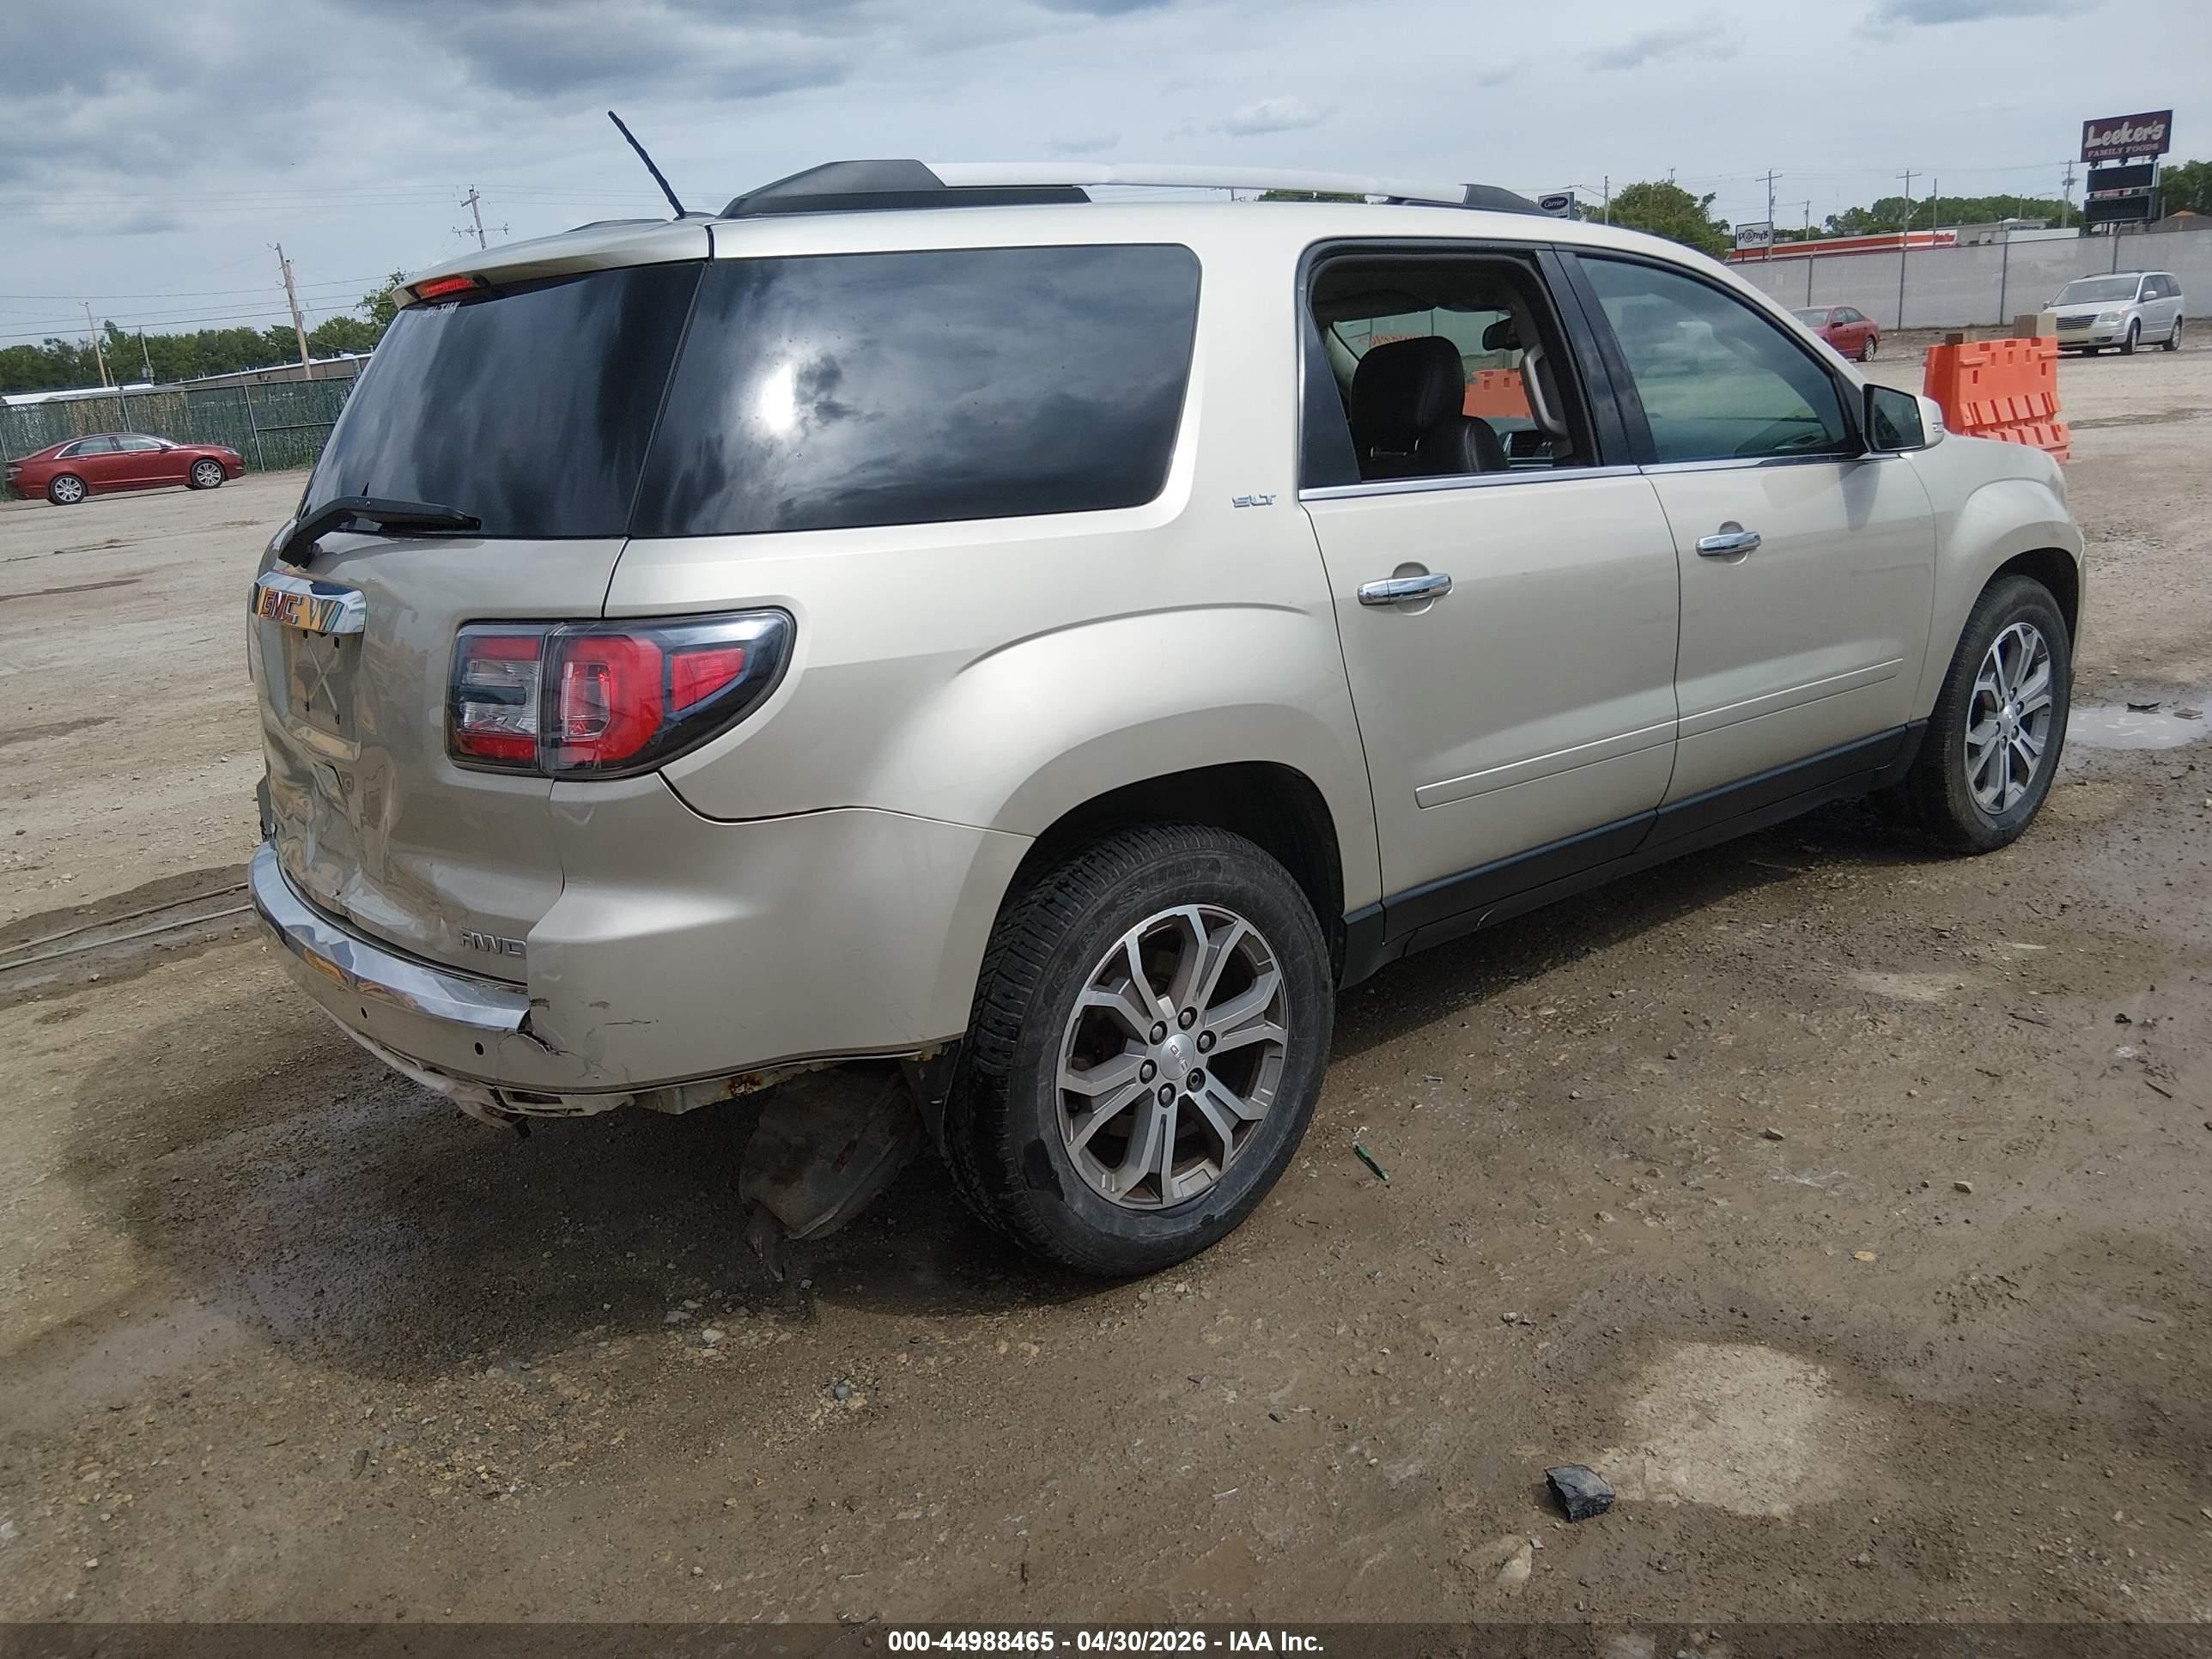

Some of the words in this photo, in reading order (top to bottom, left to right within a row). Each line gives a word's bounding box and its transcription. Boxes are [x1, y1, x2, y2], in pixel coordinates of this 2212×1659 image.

[2085, 121, 2166, 148] Leeker's
[2087, 147, 2123, 157] FAMILY
[2125, 143, 2159, 153] FOODS
[1231, 495, 1277, 508] SLT
[260, 586, 301, 624] GMC
[459, 927, 527, 960] AWD
